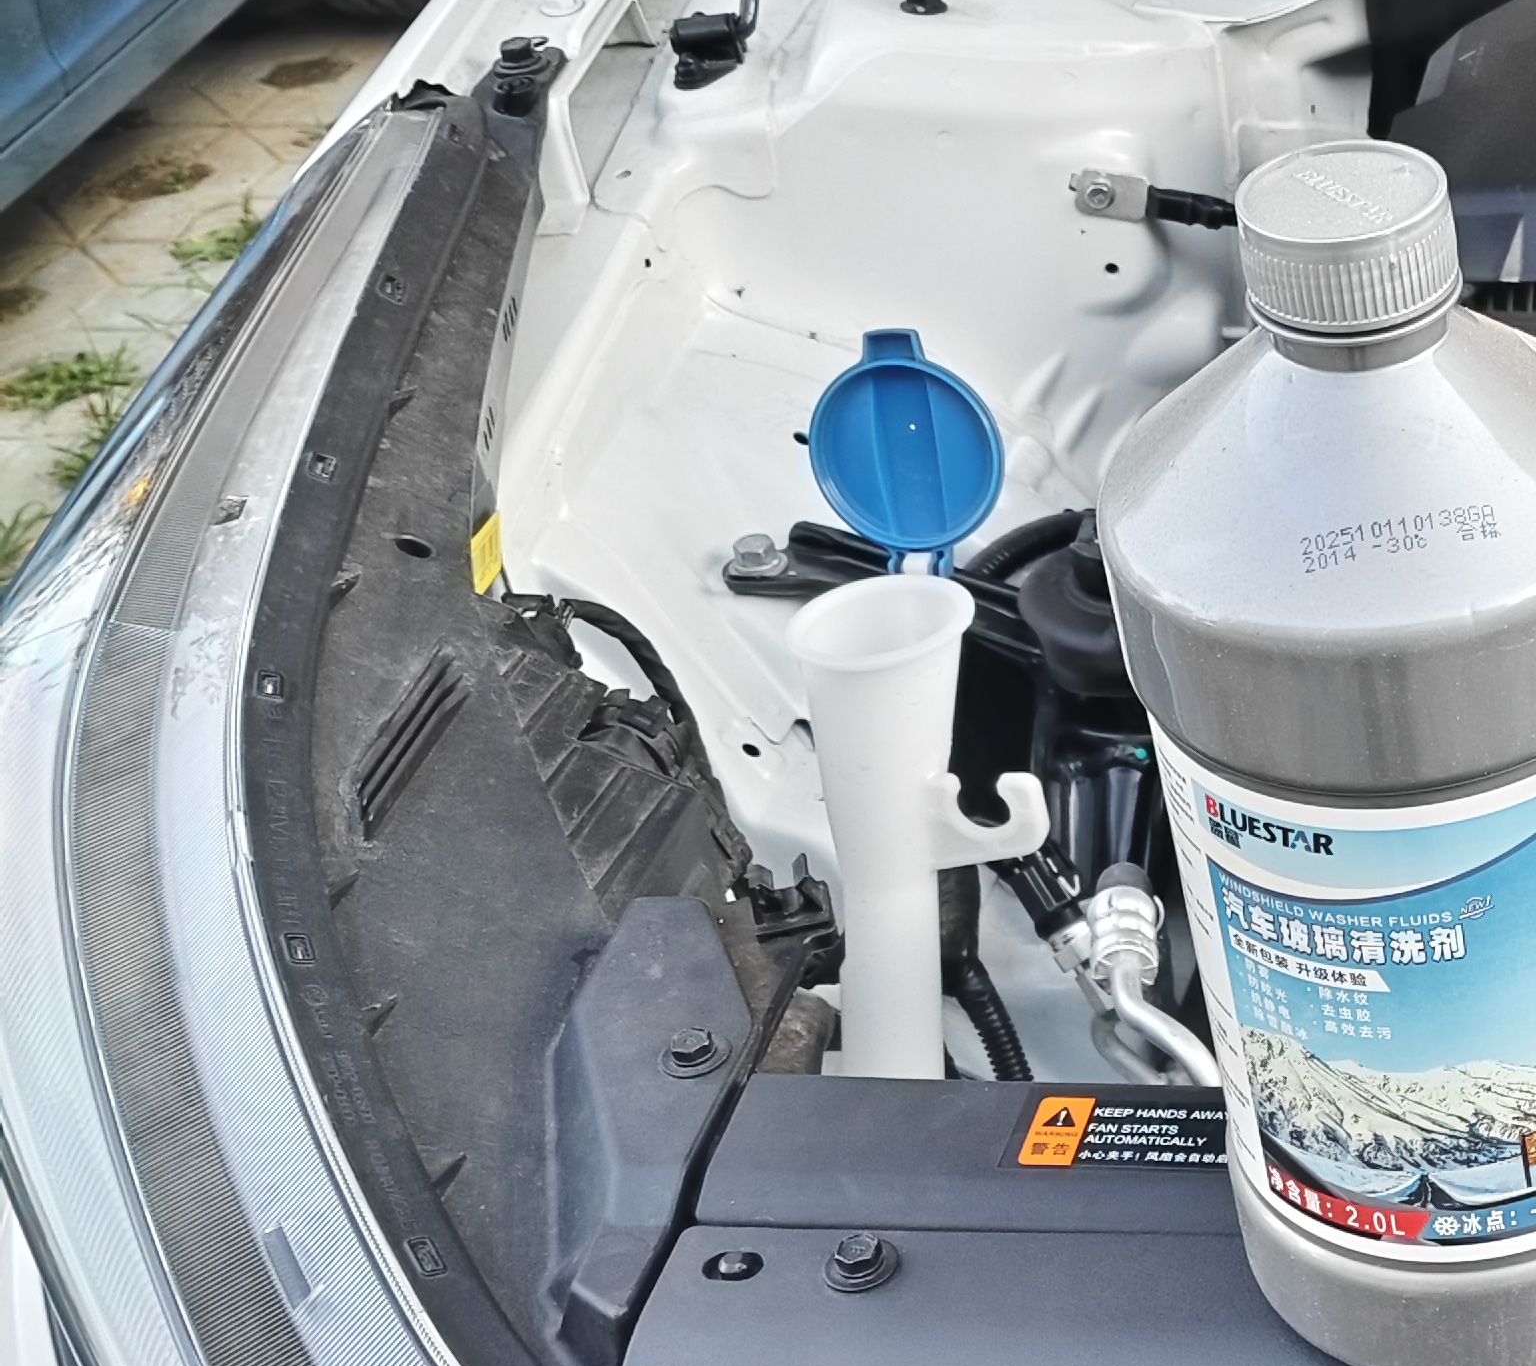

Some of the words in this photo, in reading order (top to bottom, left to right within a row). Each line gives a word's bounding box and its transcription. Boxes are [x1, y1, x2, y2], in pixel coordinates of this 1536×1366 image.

[1302, 546, 1357, 574] 2014
[1205, 793, 1334, 856] BLUESTAR
[1218, 872, 1304, 918] WINDSHIELD
[1308, 909, 1383, 927] WASHER
[1388, 912, 1453, 927] FLUIDS
[1221, 886, 1468, 966] 汽车玻璃清洗剂
[1232, 933, 1289, 971] 全新包装
[1296, 962, 1368, 987] 升级体验
[1318, 986, 1369, 1006] 除水纹
[1320, 1003, 1372, 1023] 去虫胶
[1324, 1019, 1392, 1041] 高效去污
[1093, 1107, 1134, 1119] KEEP
[1137, 1108, 1187, 1120] HANDS
[1087, 1122, 1119, 1133] FAN
[1121, 1124, 1179, 1135] STARTS
[1030, 1142, 1072, 1156] 警告
[1083, 1135, 1208, 1147] AUTOMATICALLY
